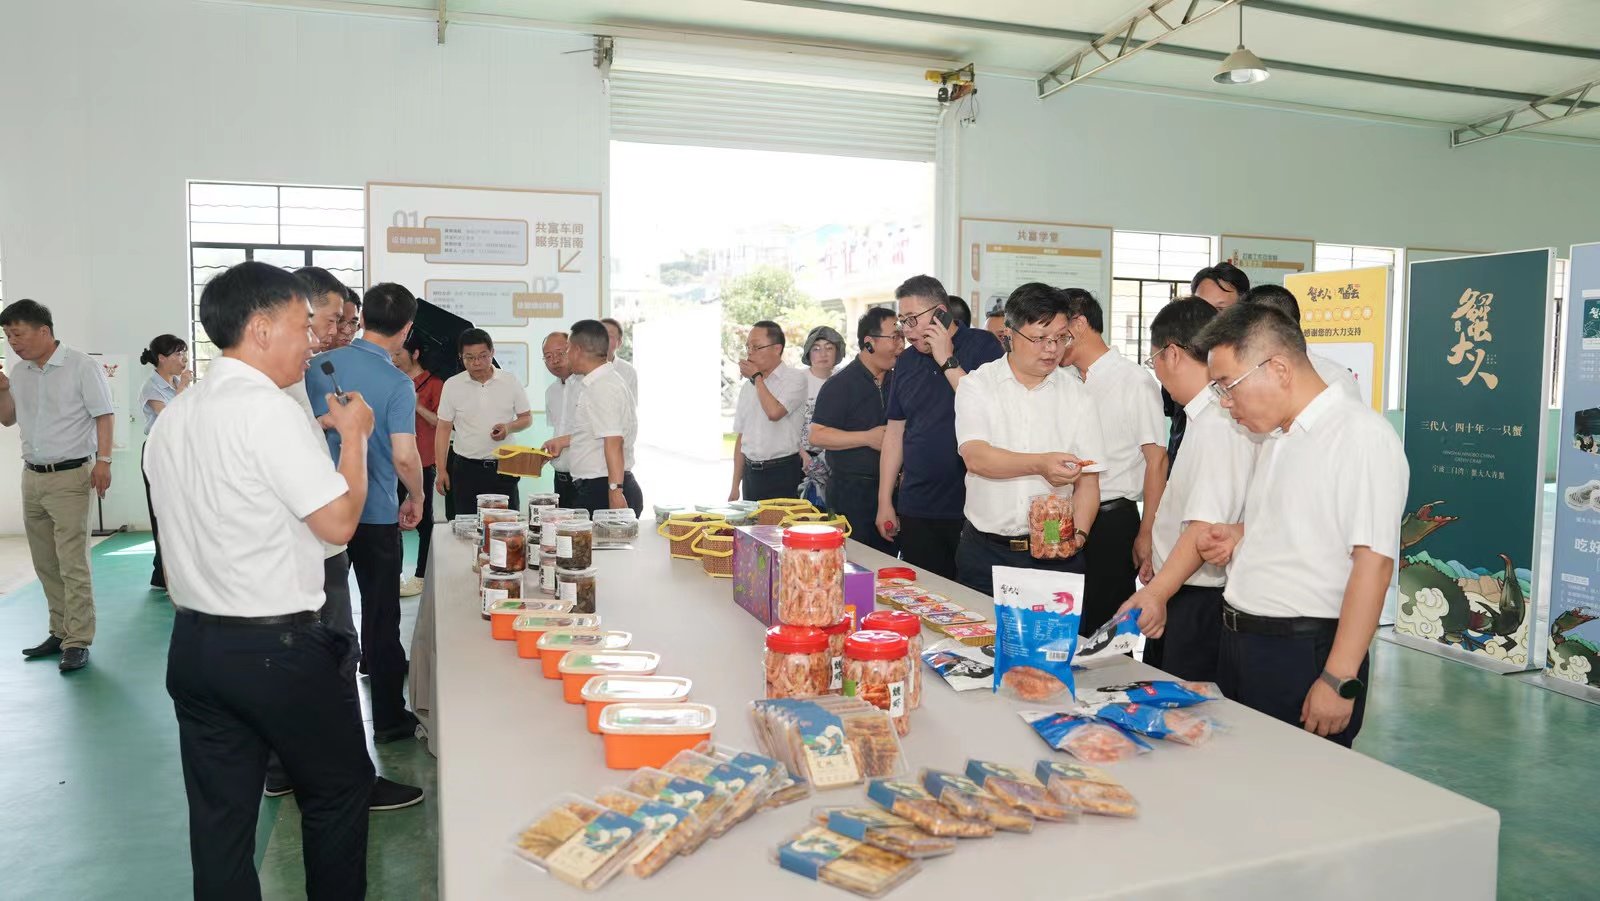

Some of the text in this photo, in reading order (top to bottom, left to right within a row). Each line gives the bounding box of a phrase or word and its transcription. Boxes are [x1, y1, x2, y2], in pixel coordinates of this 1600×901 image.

[392, 210, 419, 227] 01
[535, 221, 584, 235] 共富车间
[535, 236, 584, 249] 服务指南
[1017, 230, 1059, 242] 共富学堂
[532, 276, 560, 293] 02
[1303, 327, 1362, 338] 感谢您的大力支持
